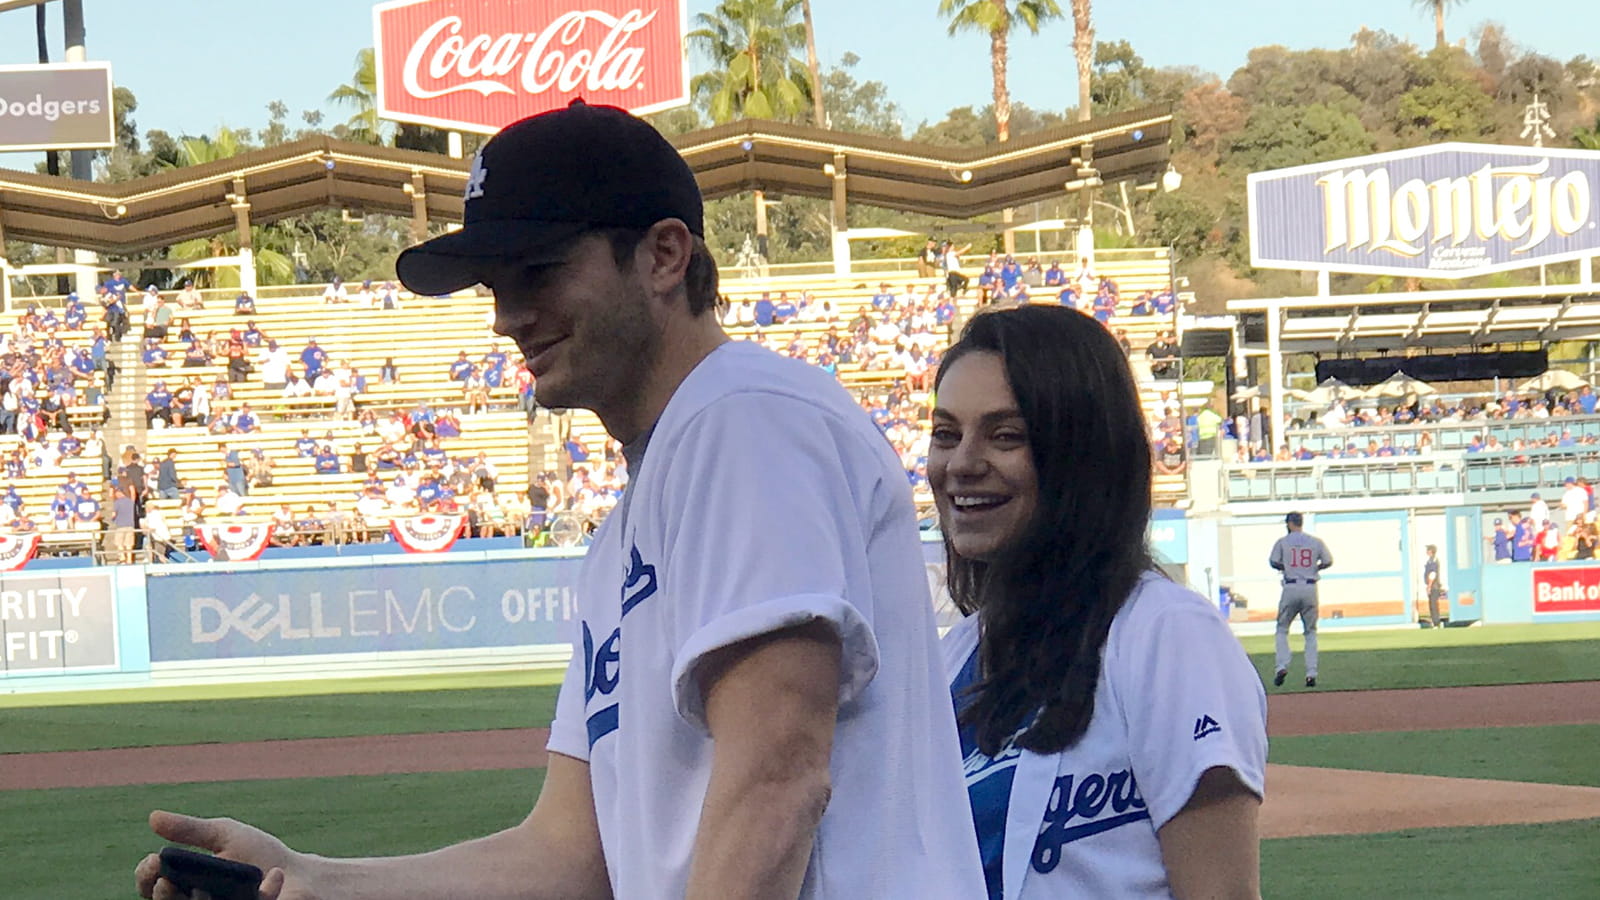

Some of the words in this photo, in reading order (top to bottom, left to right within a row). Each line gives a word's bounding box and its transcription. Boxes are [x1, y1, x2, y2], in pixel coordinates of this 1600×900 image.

[1314, 157, 1591, 256] Montejo
[1290, 548, 1313, 568] 18
[1537, 580, 1586, 602] Bank
[1587, 582, 1600, 600] o
[189, 592, 342, 644] DELL
[348, 586, 477, 638] EMC
